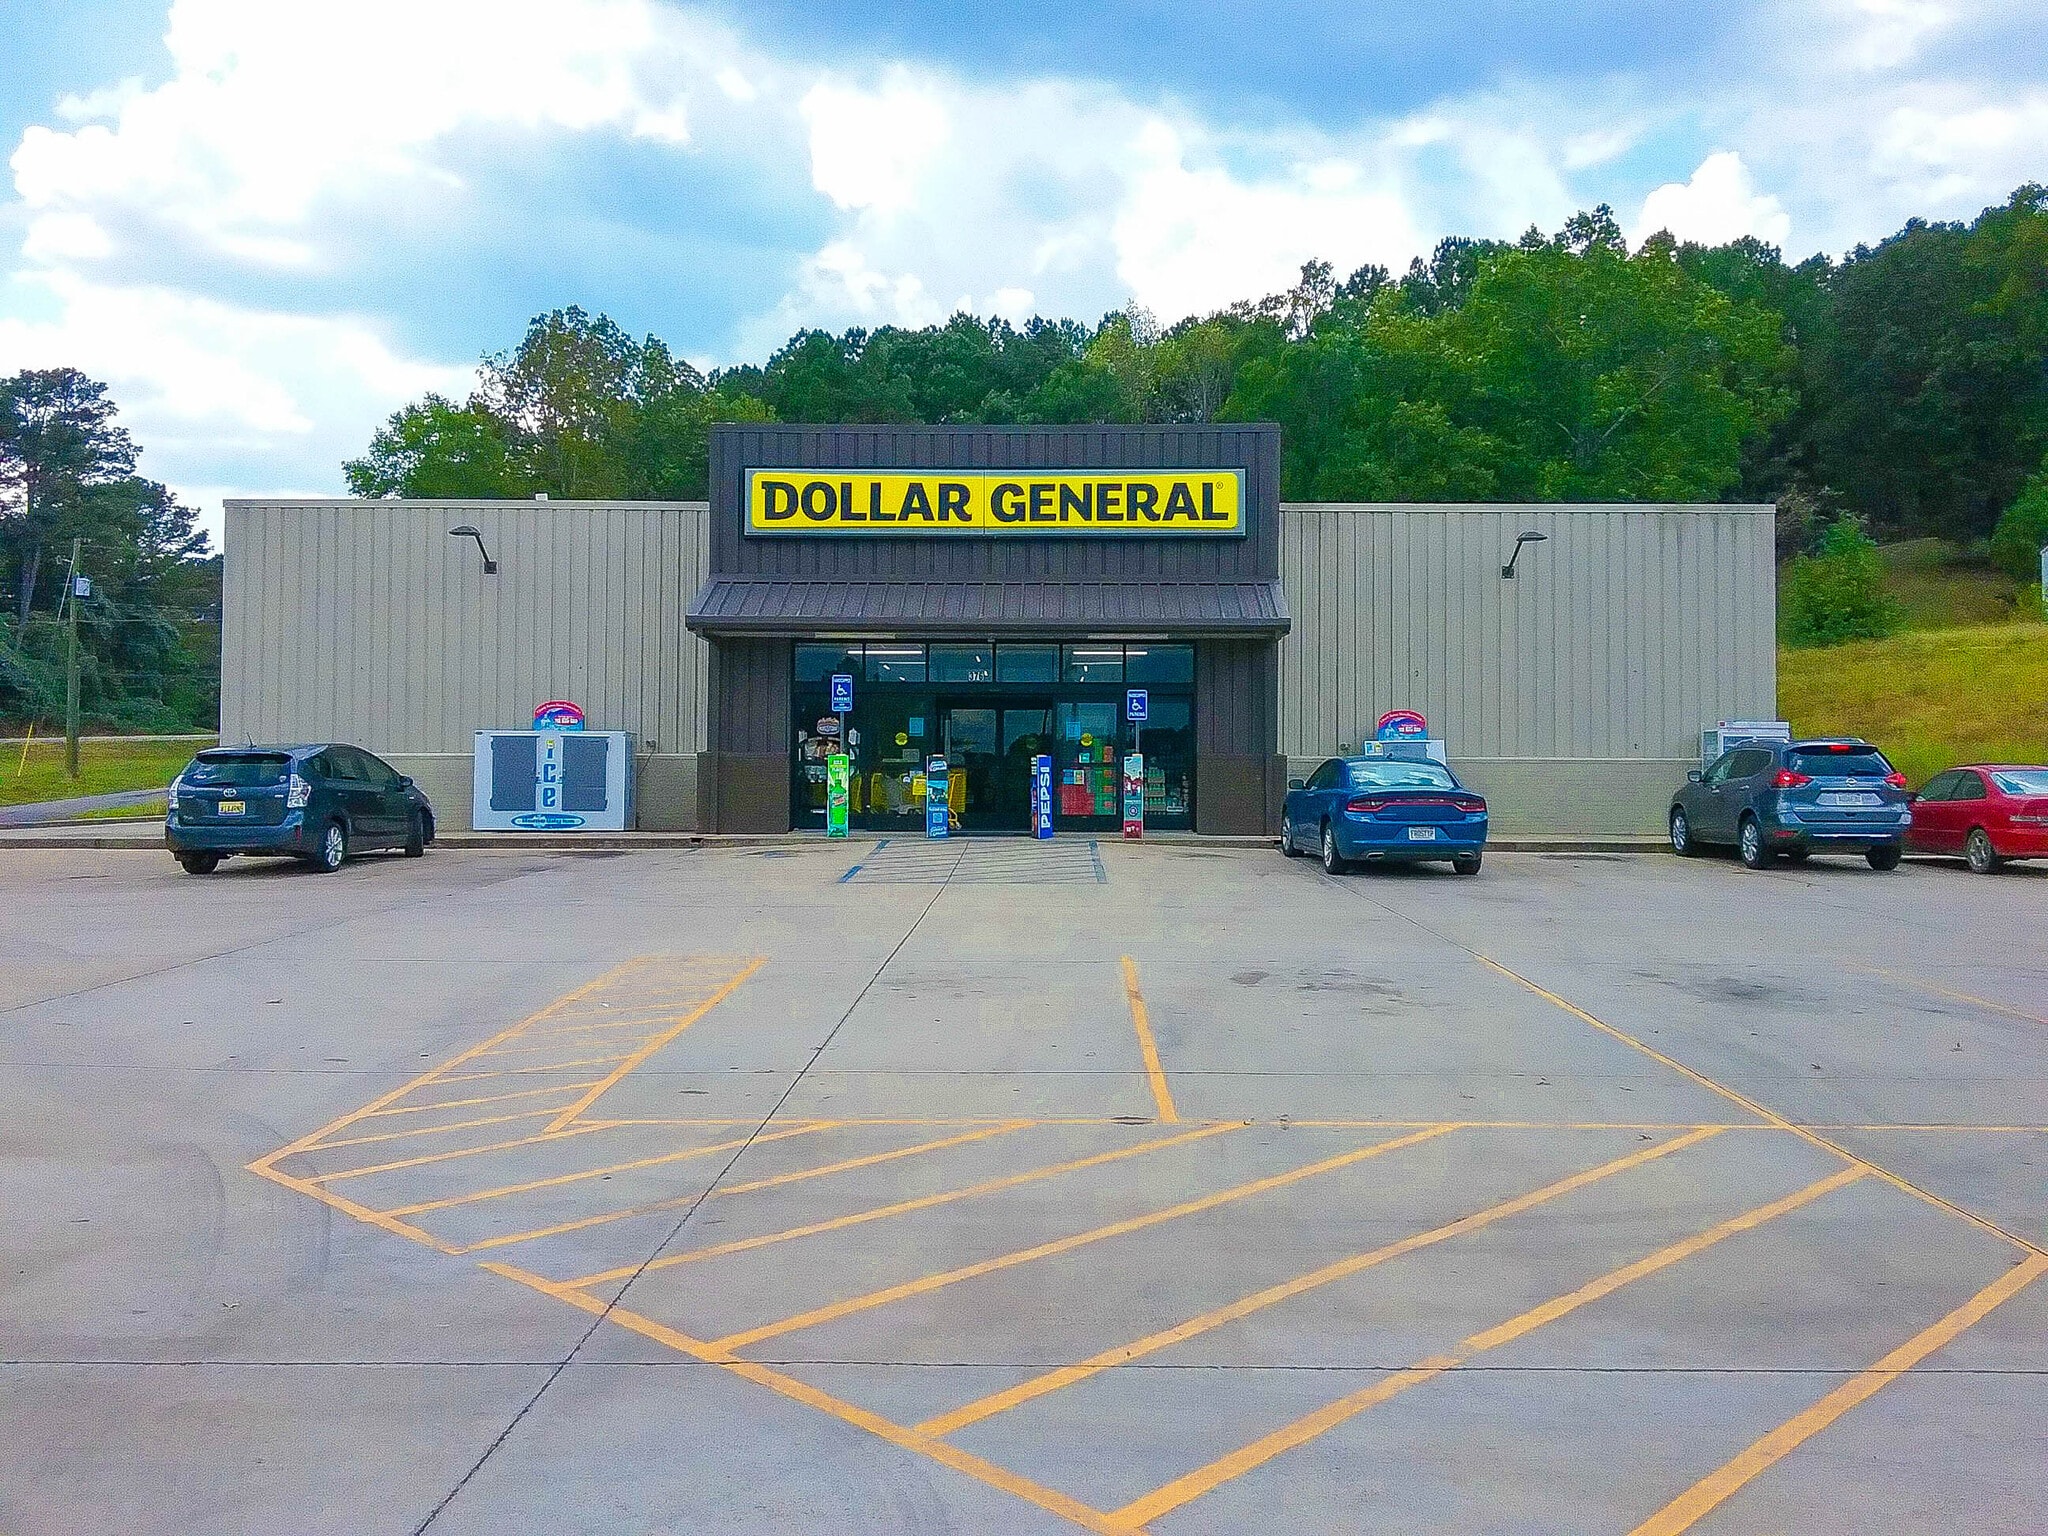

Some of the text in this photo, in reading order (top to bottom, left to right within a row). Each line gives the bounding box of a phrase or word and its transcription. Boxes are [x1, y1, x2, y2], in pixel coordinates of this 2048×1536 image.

[761, 480, 1230, 522] DOLLAR GENERAL
[543, 740, 557, 808] ice
[1040, 766, 1051, 829] PEPSI
